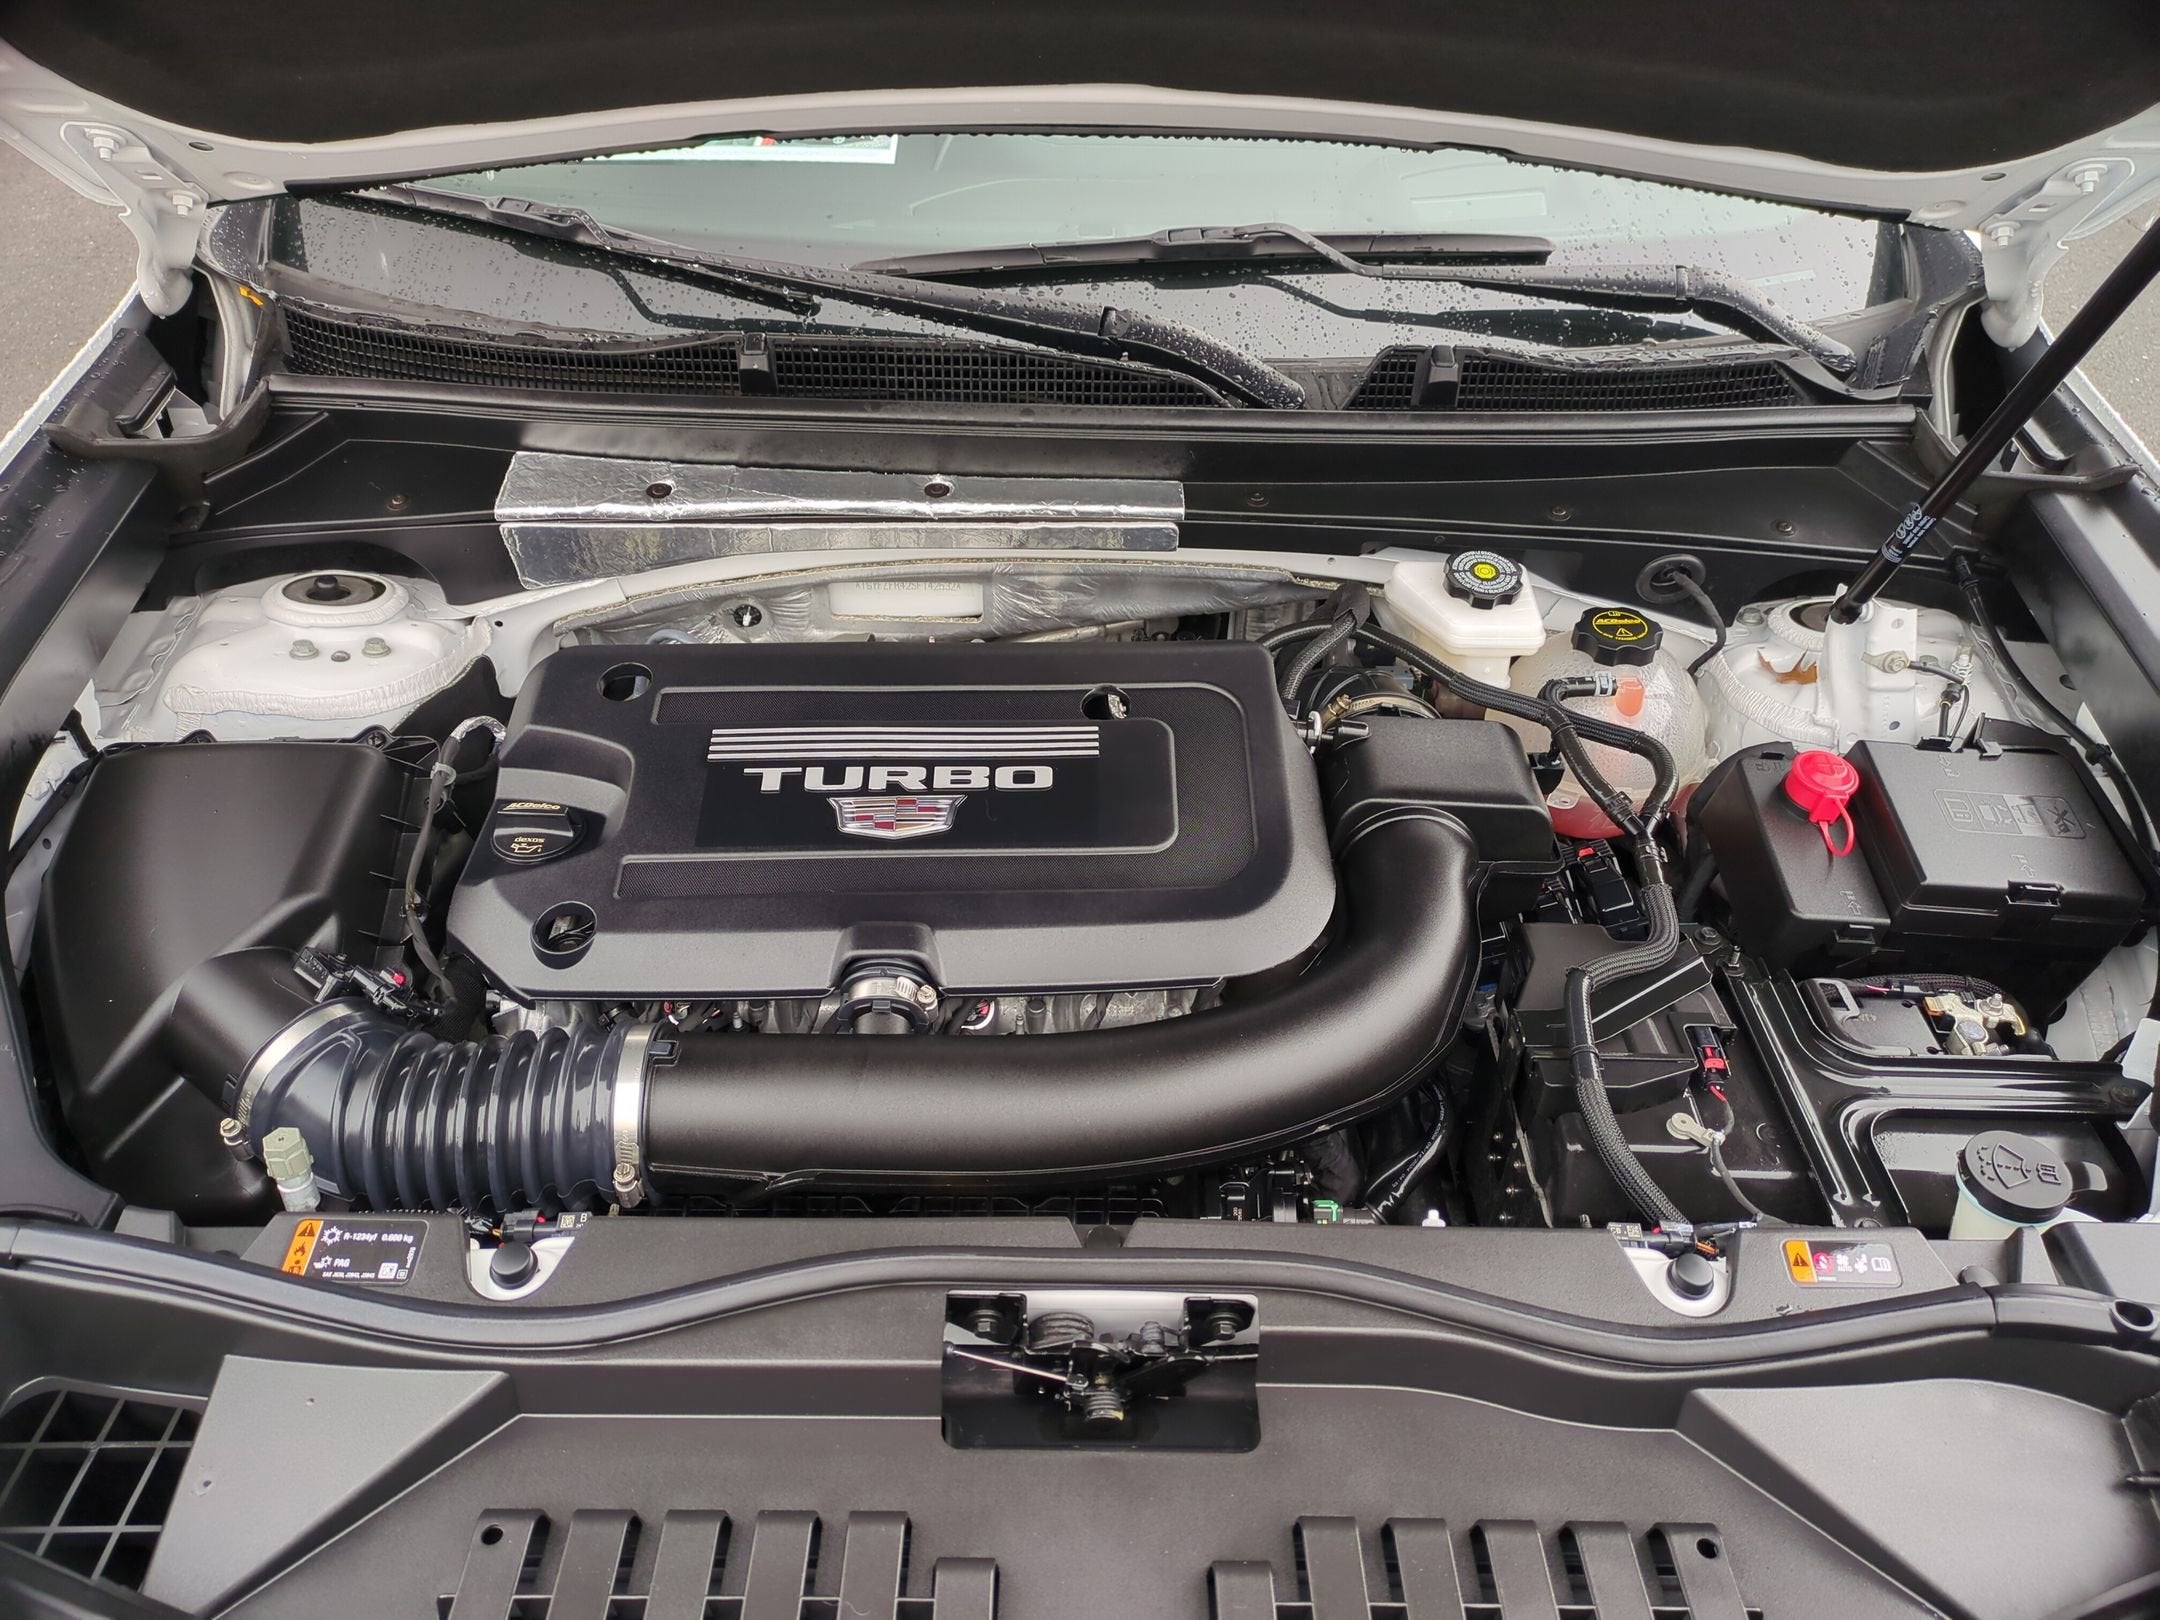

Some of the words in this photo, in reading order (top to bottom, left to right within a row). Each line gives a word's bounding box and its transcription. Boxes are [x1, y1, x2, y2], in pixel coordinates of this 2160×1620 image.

[743, 765, 1053, 793] TURBO
[502, 802, 561, 811] ACDelco
[403, 1234, 414, 1244] kg
[333, 1258, 350, 1267] PAG
